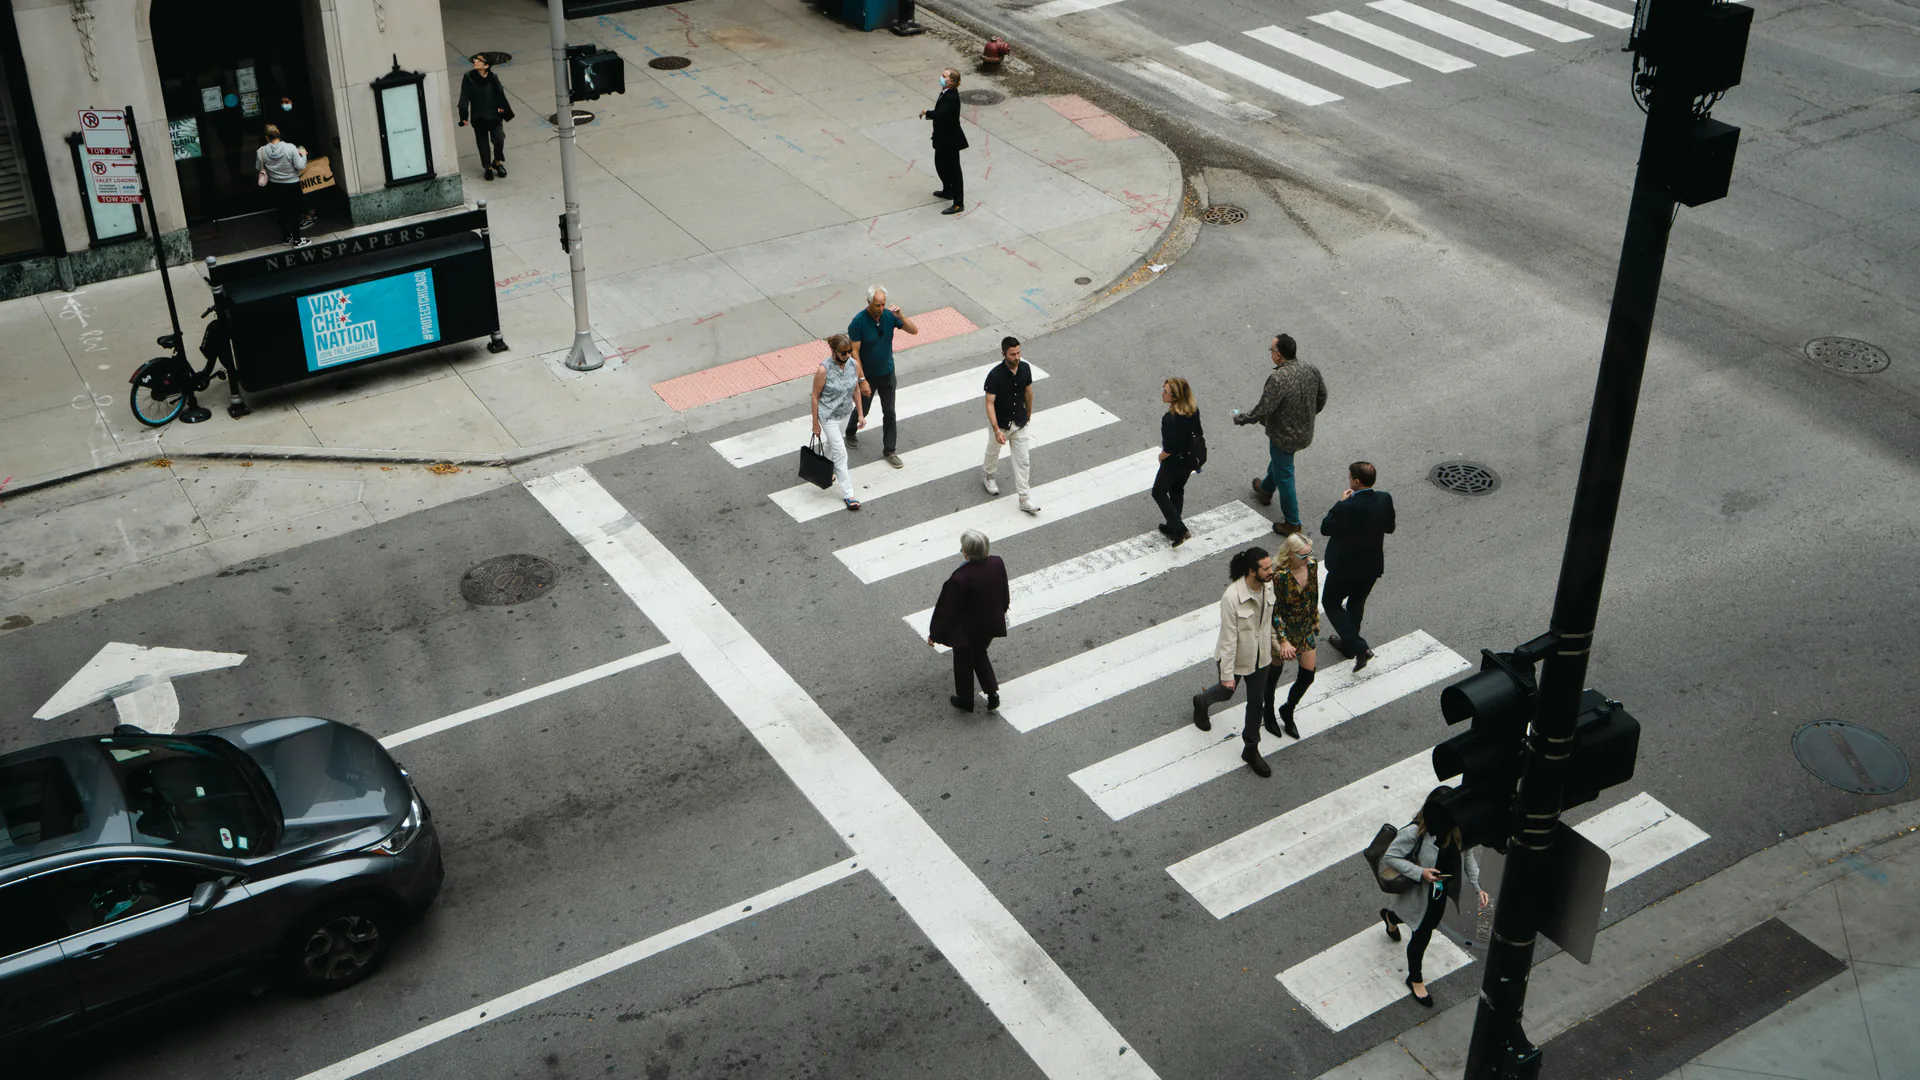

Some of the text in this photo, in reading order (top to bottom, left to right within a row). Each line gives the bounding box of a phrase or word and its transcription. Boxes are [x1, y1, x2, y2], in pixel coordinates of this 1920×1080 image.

[169, 131, 181, 139] HE
[300, 174, 322, 190] NIKE
[265, 226, 426, 271] NEWSPAPERS
[310, 292, 342, 314] VAX
[414, 271, 435, 340] #PROTECTCHICAGO
[315, 322, 375, 352] NATION
[319, 340, 376, 359] JOIN THE MOVEMENT
